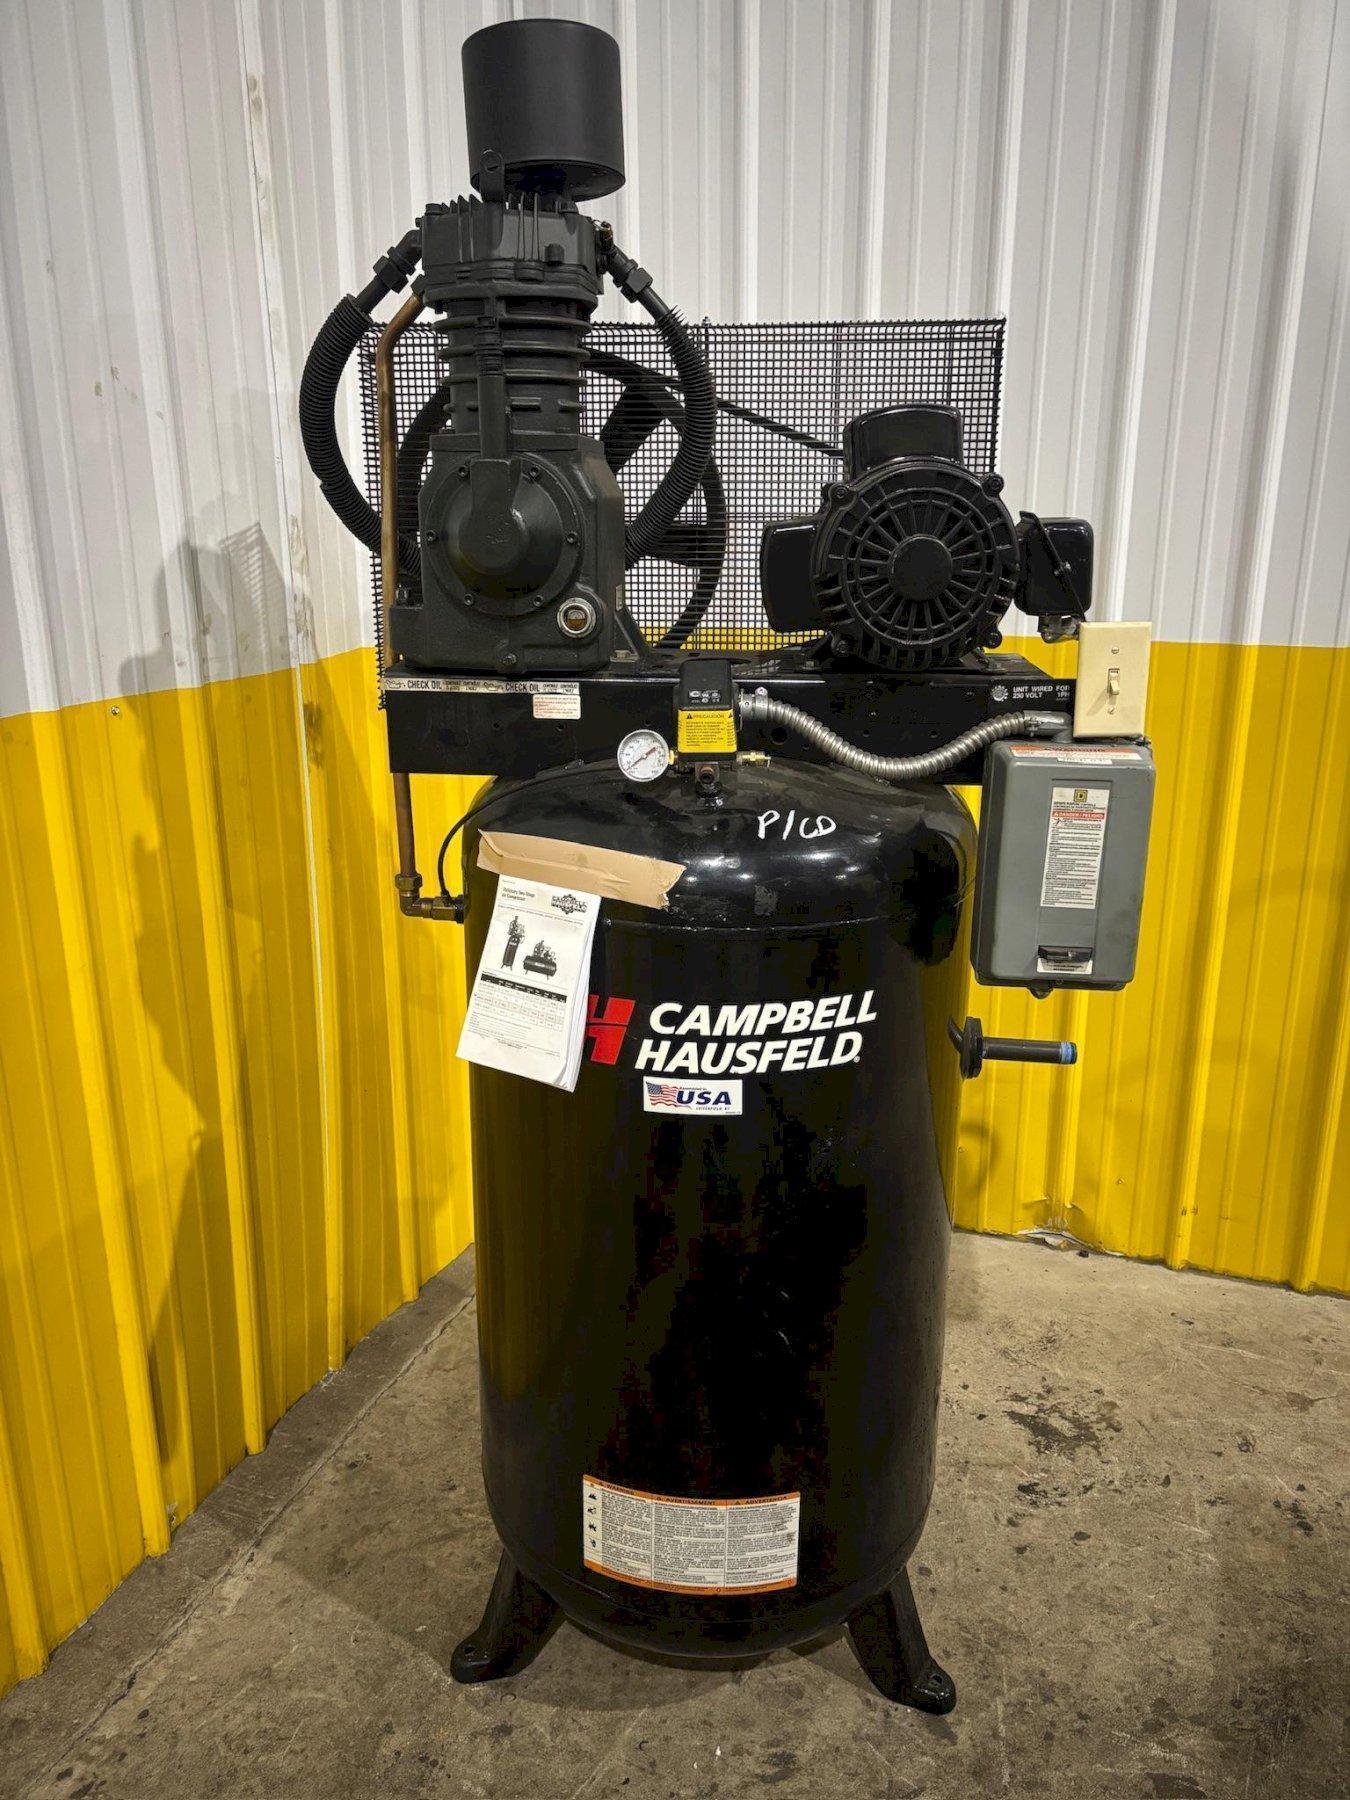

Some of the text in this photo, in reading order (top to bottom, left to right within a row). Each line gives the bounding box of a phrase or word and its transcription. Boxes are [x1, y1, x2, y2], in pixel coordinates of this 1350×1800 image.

[407, 680, 430, 689] CHECK
[431, 681, 442, 690] OIL
[505, 682, 528, 692] CHECK
[529, 683, 541, 692] OIL
[649, 990, 878, 1036] CAMPBELL
[634, 1031, 864, 1075] HAUSFELD
[676, 1090, 732, 1106] USA
[606, 1484, 635, 1496] WARNING
